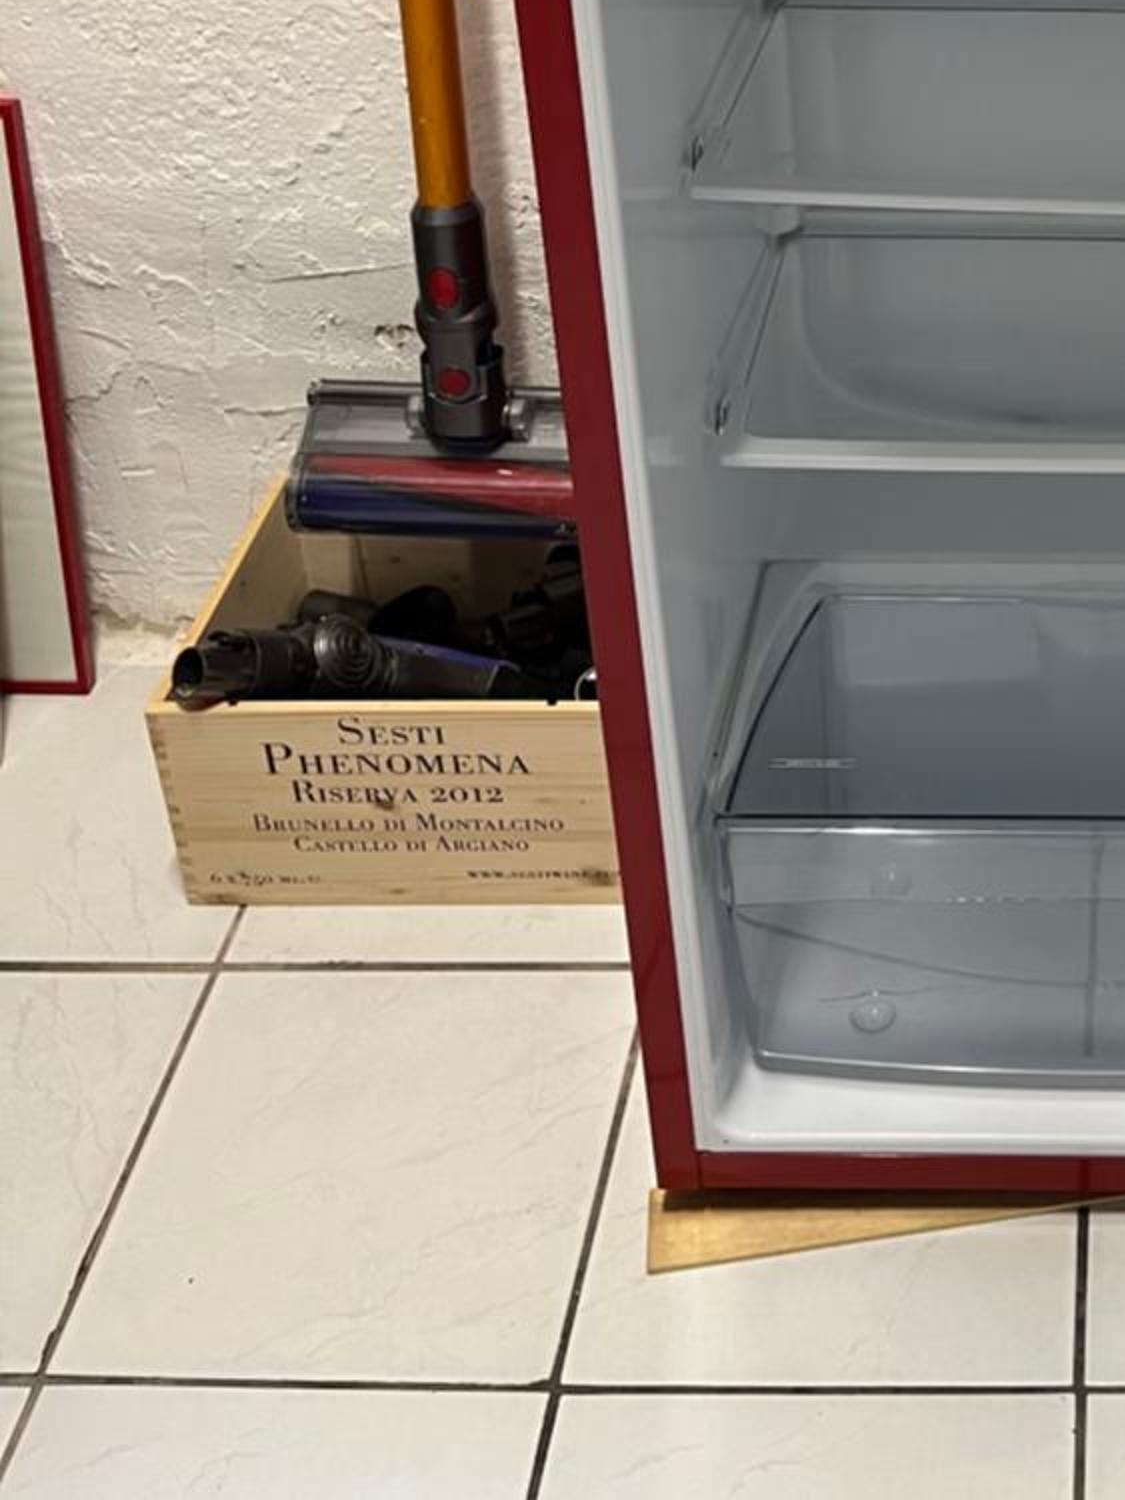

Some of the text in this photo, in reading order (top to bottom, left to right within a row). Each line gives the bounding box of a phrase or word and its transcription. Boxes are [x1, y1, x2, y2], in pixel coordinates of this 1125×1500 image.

[261, 741, 532, 775] PHENOMENA
[291, 779, 505, 804] RISERVA 2012
[253, 813, 375, 832] BRUNELLO
[416, 812, 565, 832] MONTALCINO
[294, 835, 399, 852] CASTELLO
